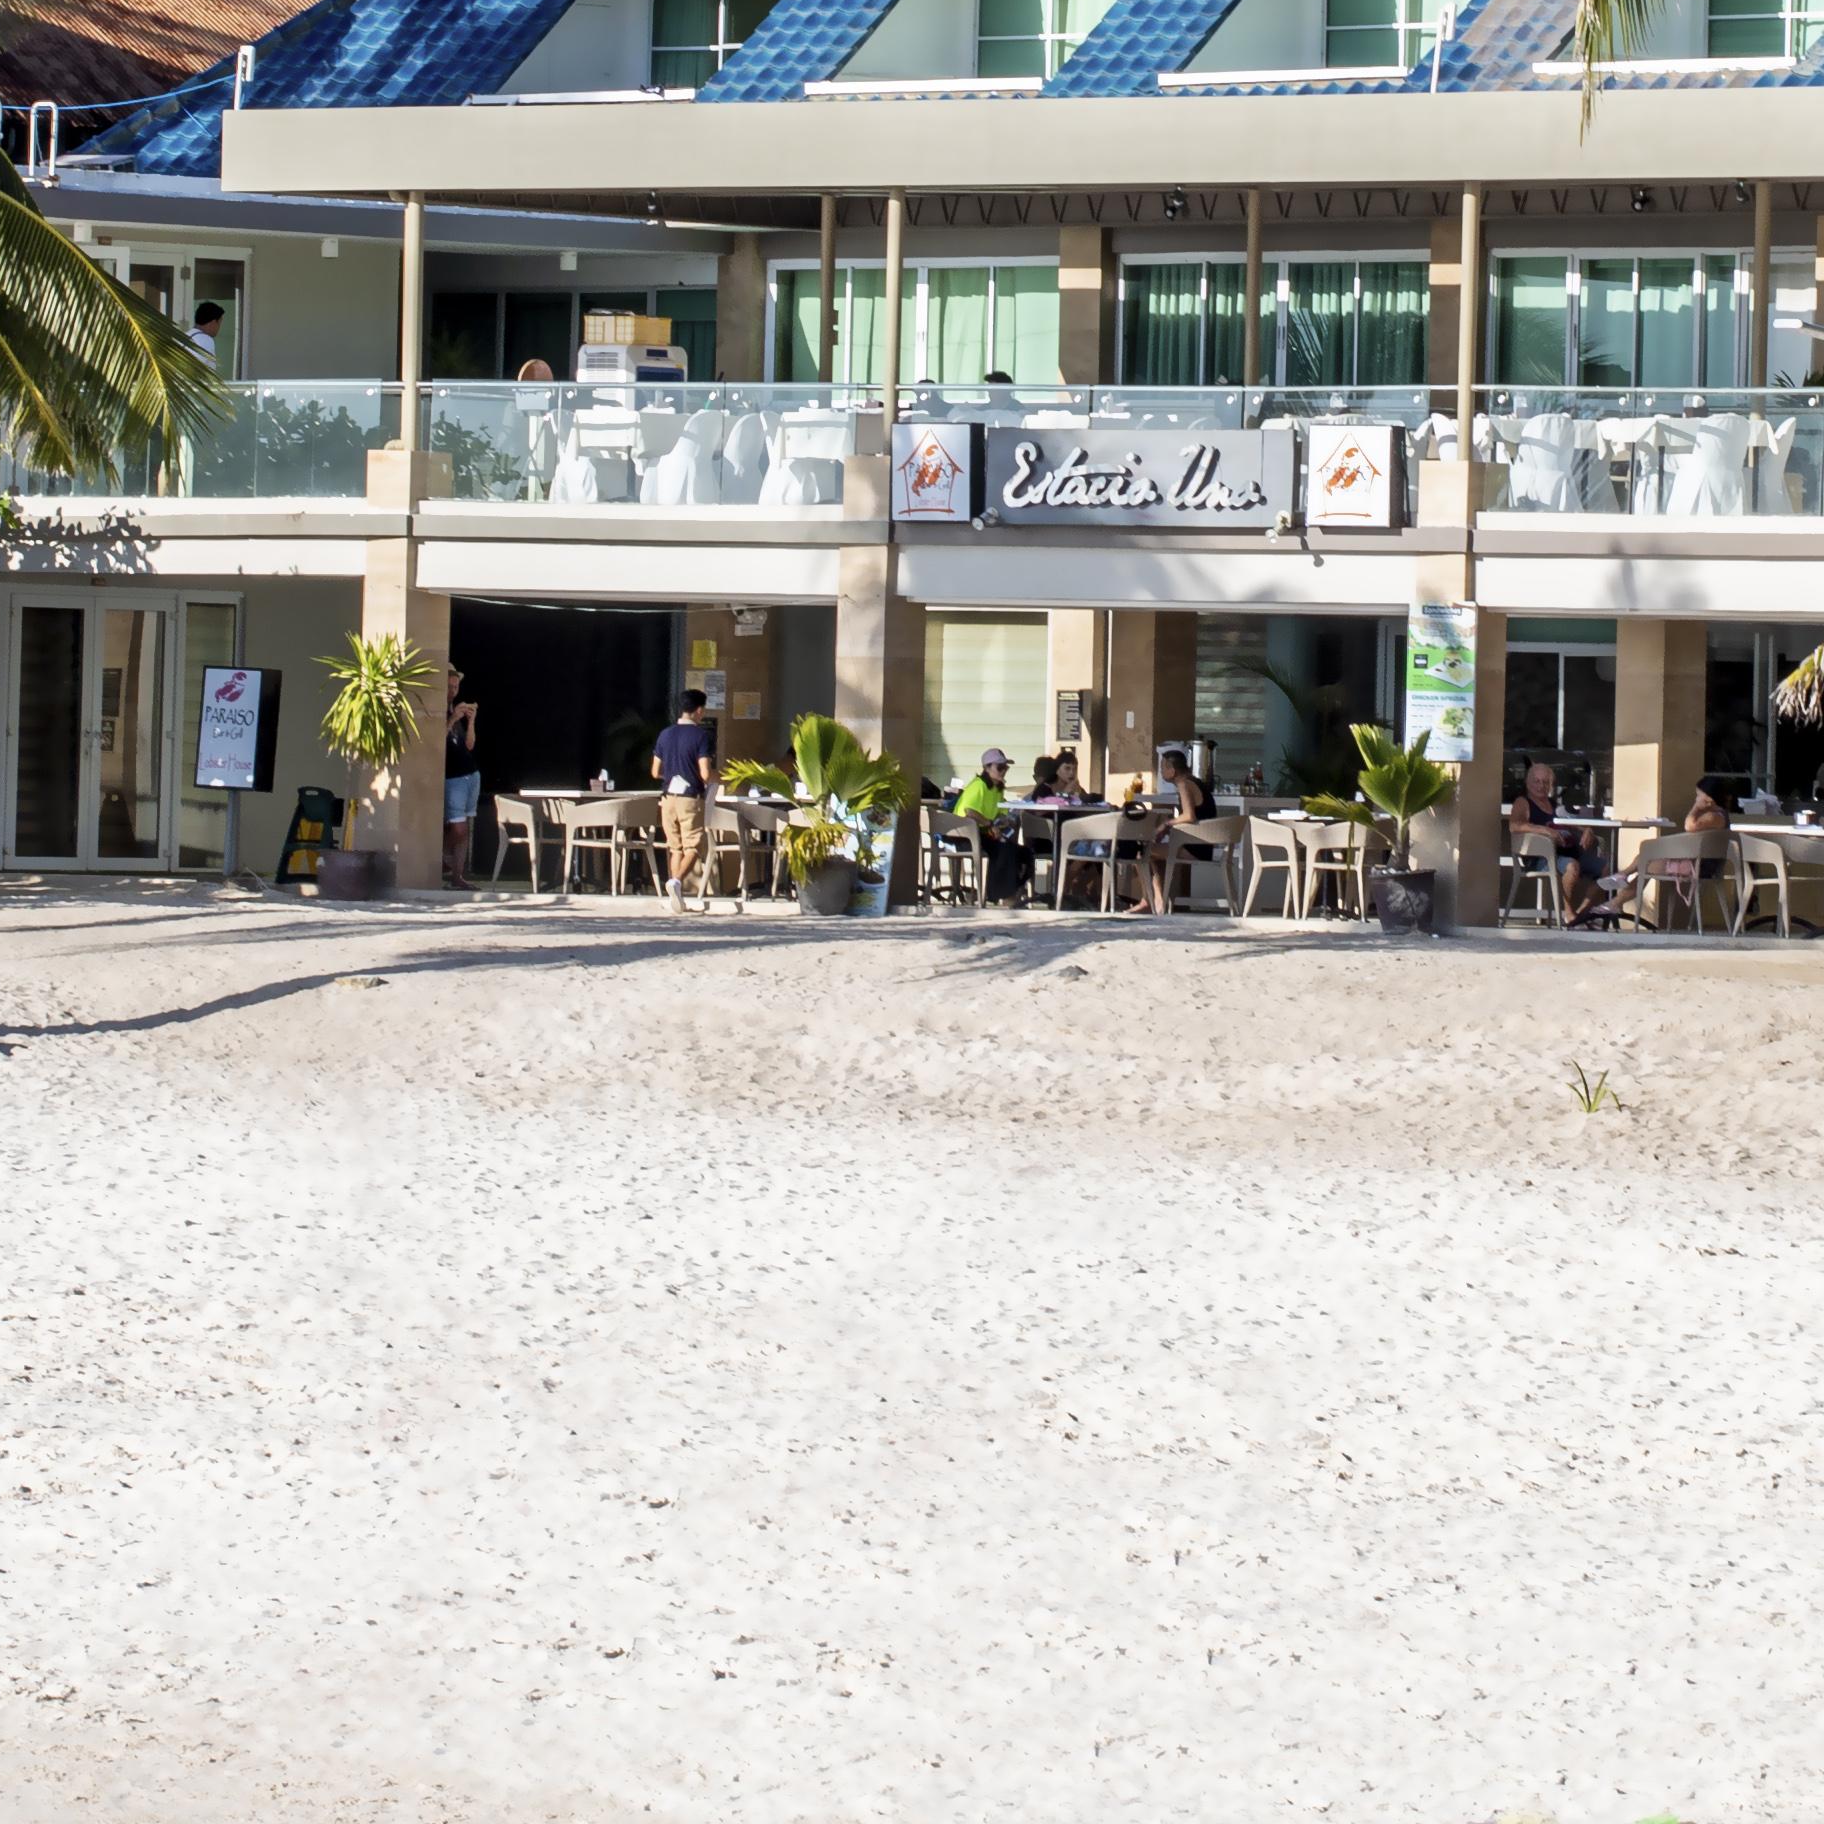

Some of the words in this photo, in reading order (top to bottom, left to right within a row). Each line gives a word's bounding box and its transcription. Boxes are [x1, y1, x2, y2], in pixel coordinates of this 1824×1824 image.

[1003, 441, 1158, 509] Estacio
[1167, 443, 1263, 510] Uno
[204, 705, 255, 727] PARAISO
